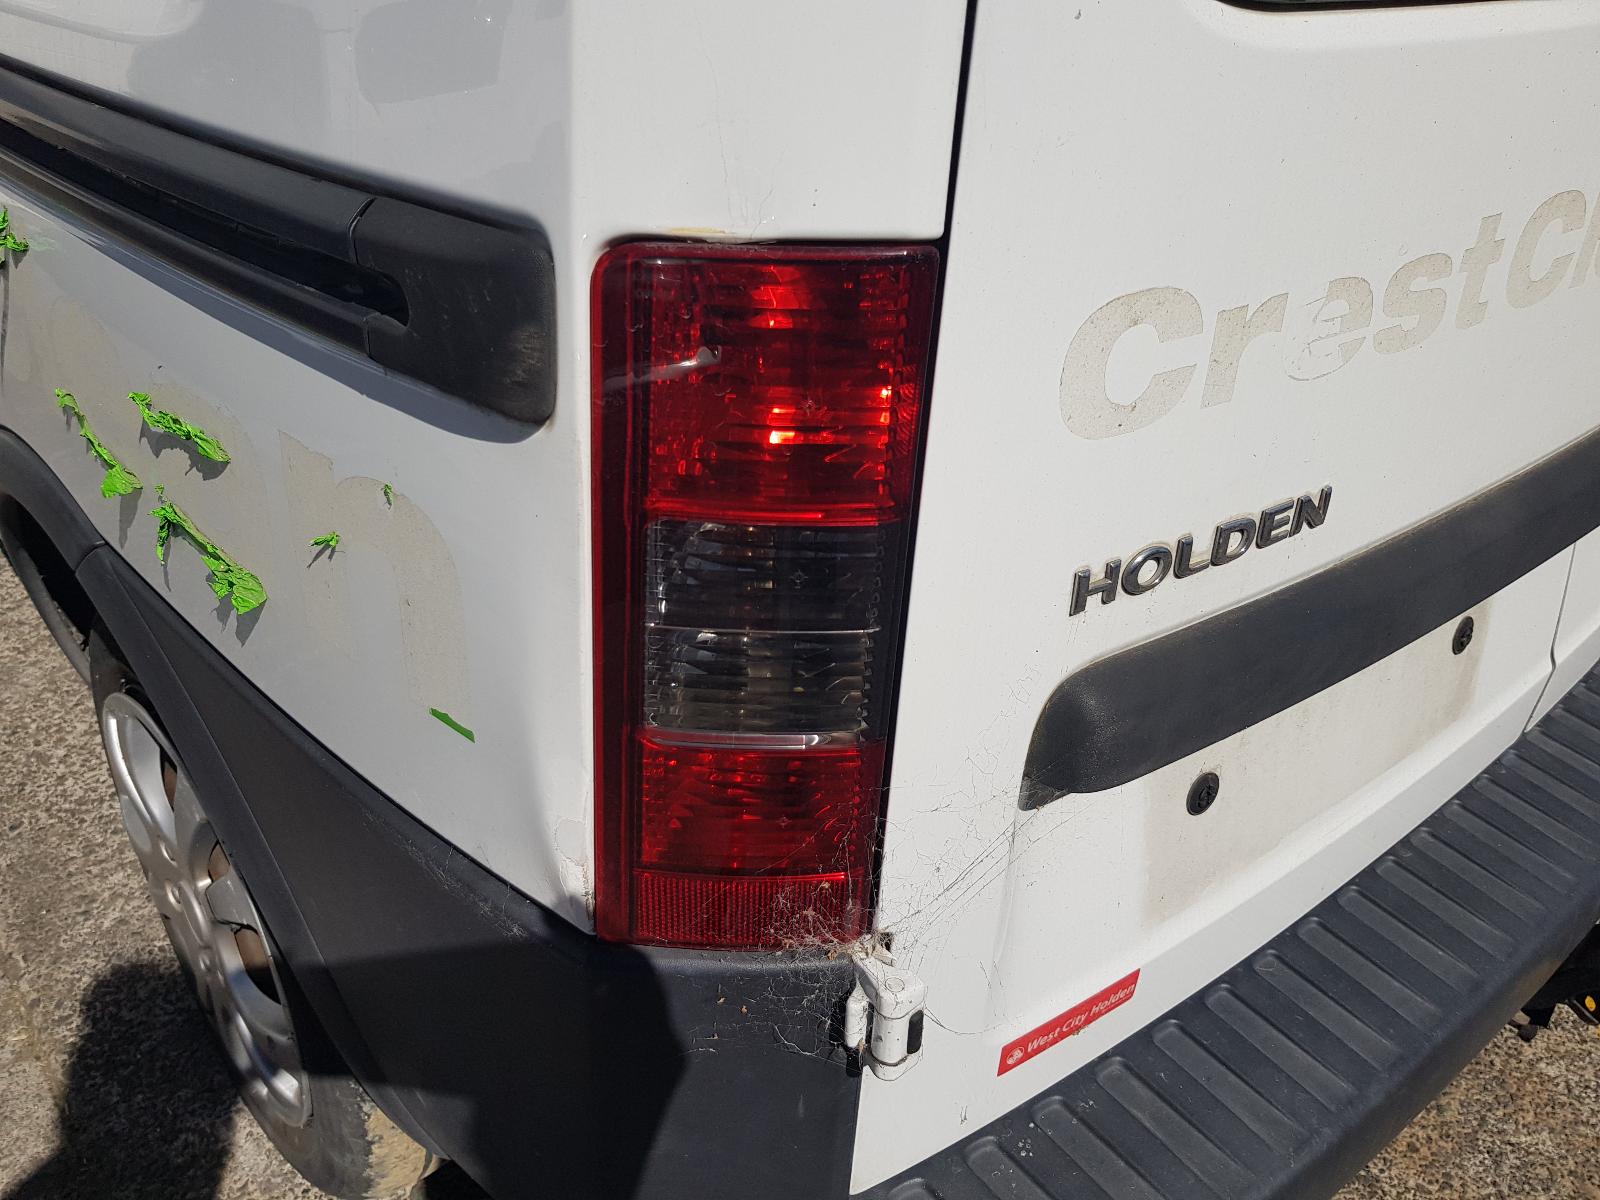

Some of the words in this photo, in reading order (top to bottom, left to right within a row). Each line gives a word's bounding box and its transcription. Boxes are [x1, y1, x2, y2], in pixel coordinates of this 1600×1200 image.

[1059, 188, 1600, 440] CrestCl
[1069, 485, 1333, 617] HOLDEN
[1027, 1028, 1061, 1053] West
[1062, 1011, 1089, 1032] City
[1089, 984, 1136, 1017] Holden
